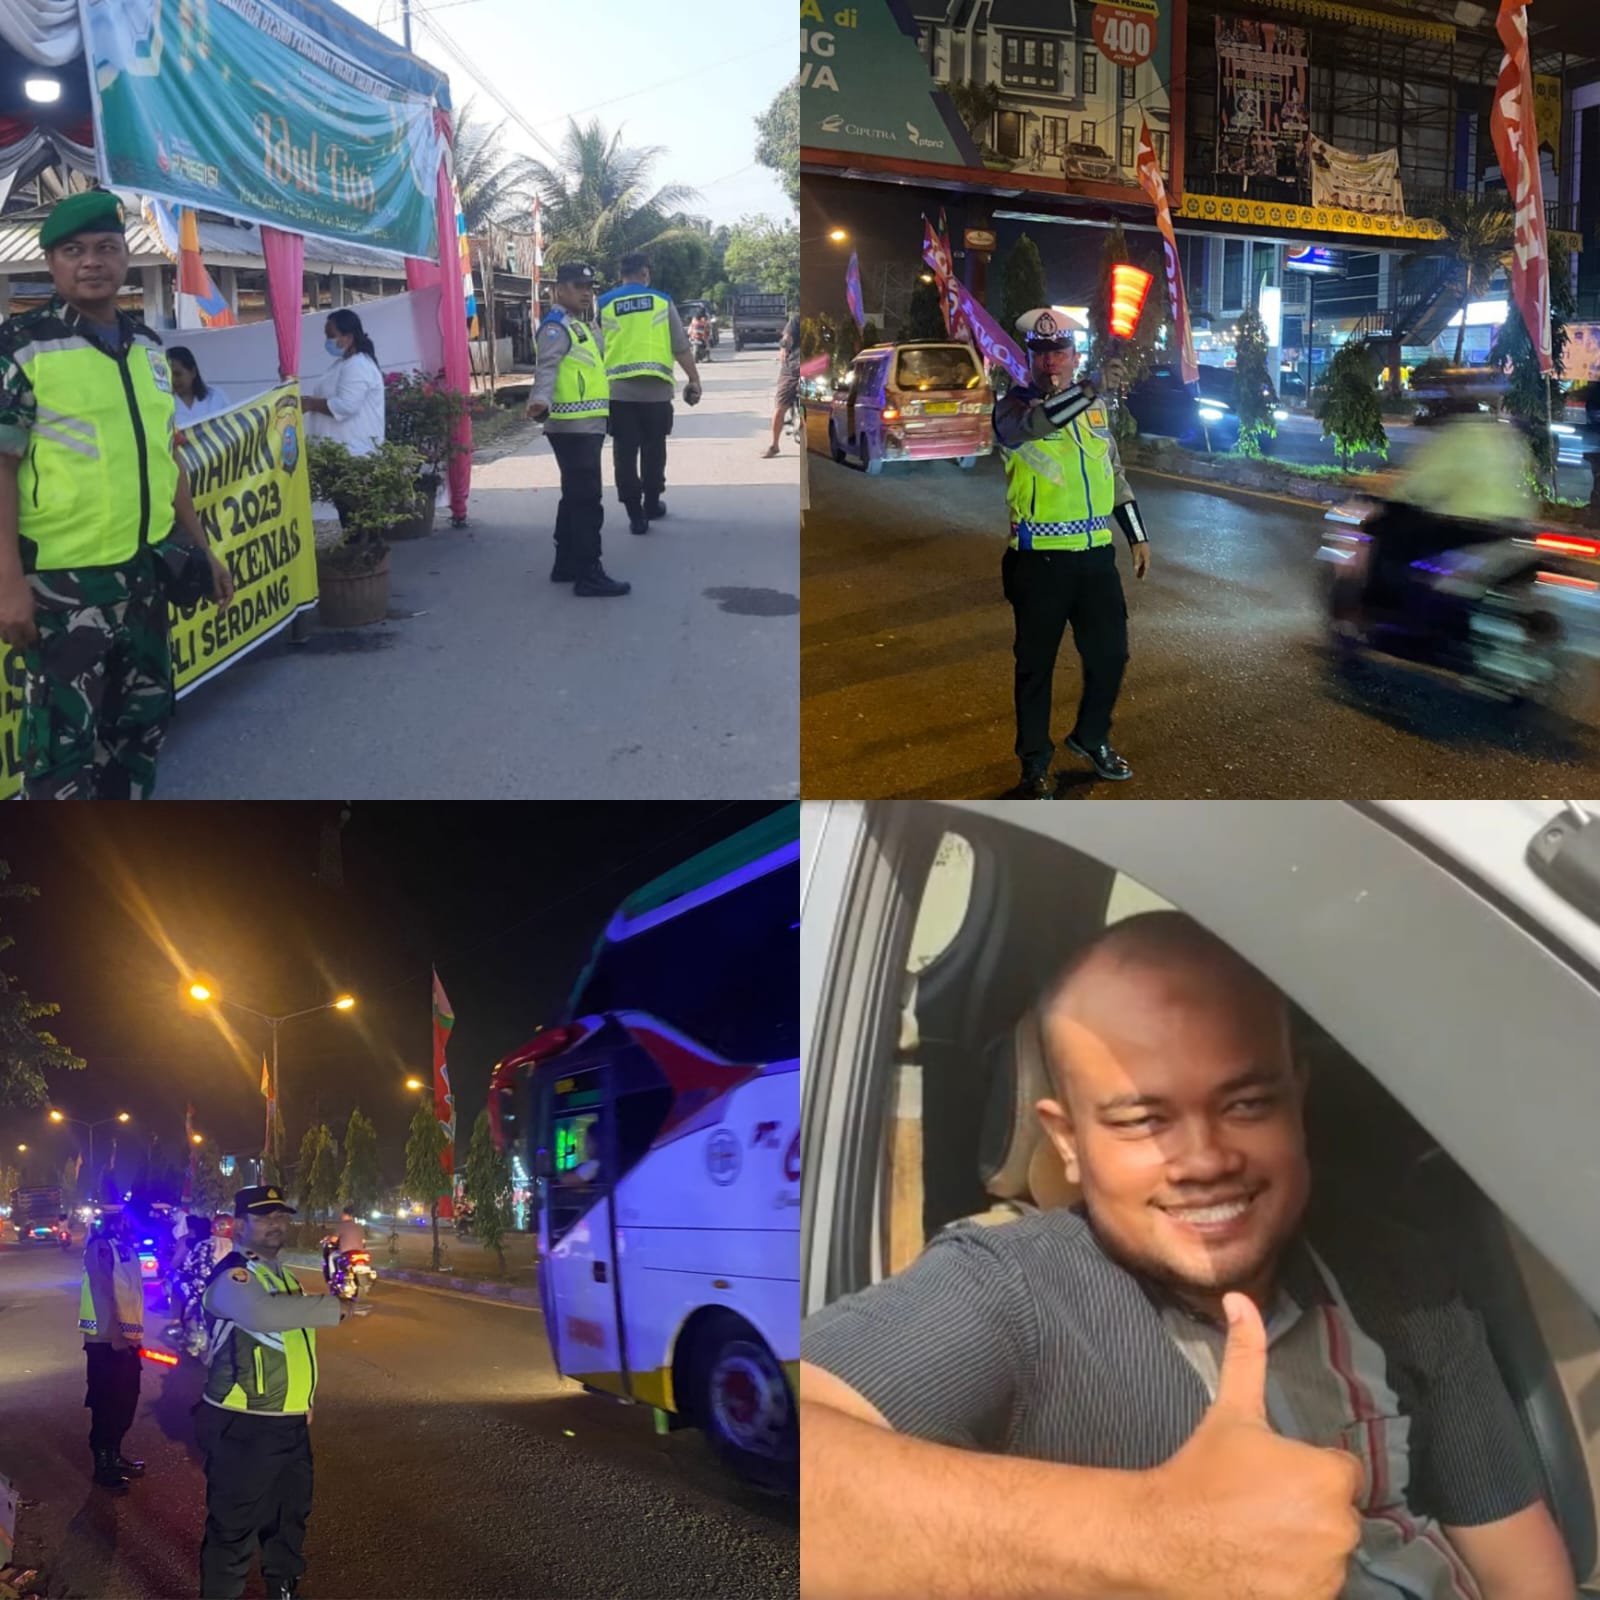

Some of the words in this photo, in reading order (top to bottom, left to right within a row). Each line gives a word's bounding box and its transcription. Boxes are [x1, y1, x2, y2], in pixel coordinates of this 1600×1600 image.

[834, 8, 857, 29] di
[1103, 17, 1151, 57] 400
[844, 124, 896, 141] CIPUTRA
[616, 297, 652, 314] POLISI
[223, 481, 281, 536] 2023
[225, 518, 301, 592] KENAS
[202, 575, 290, 657] SERDANG
